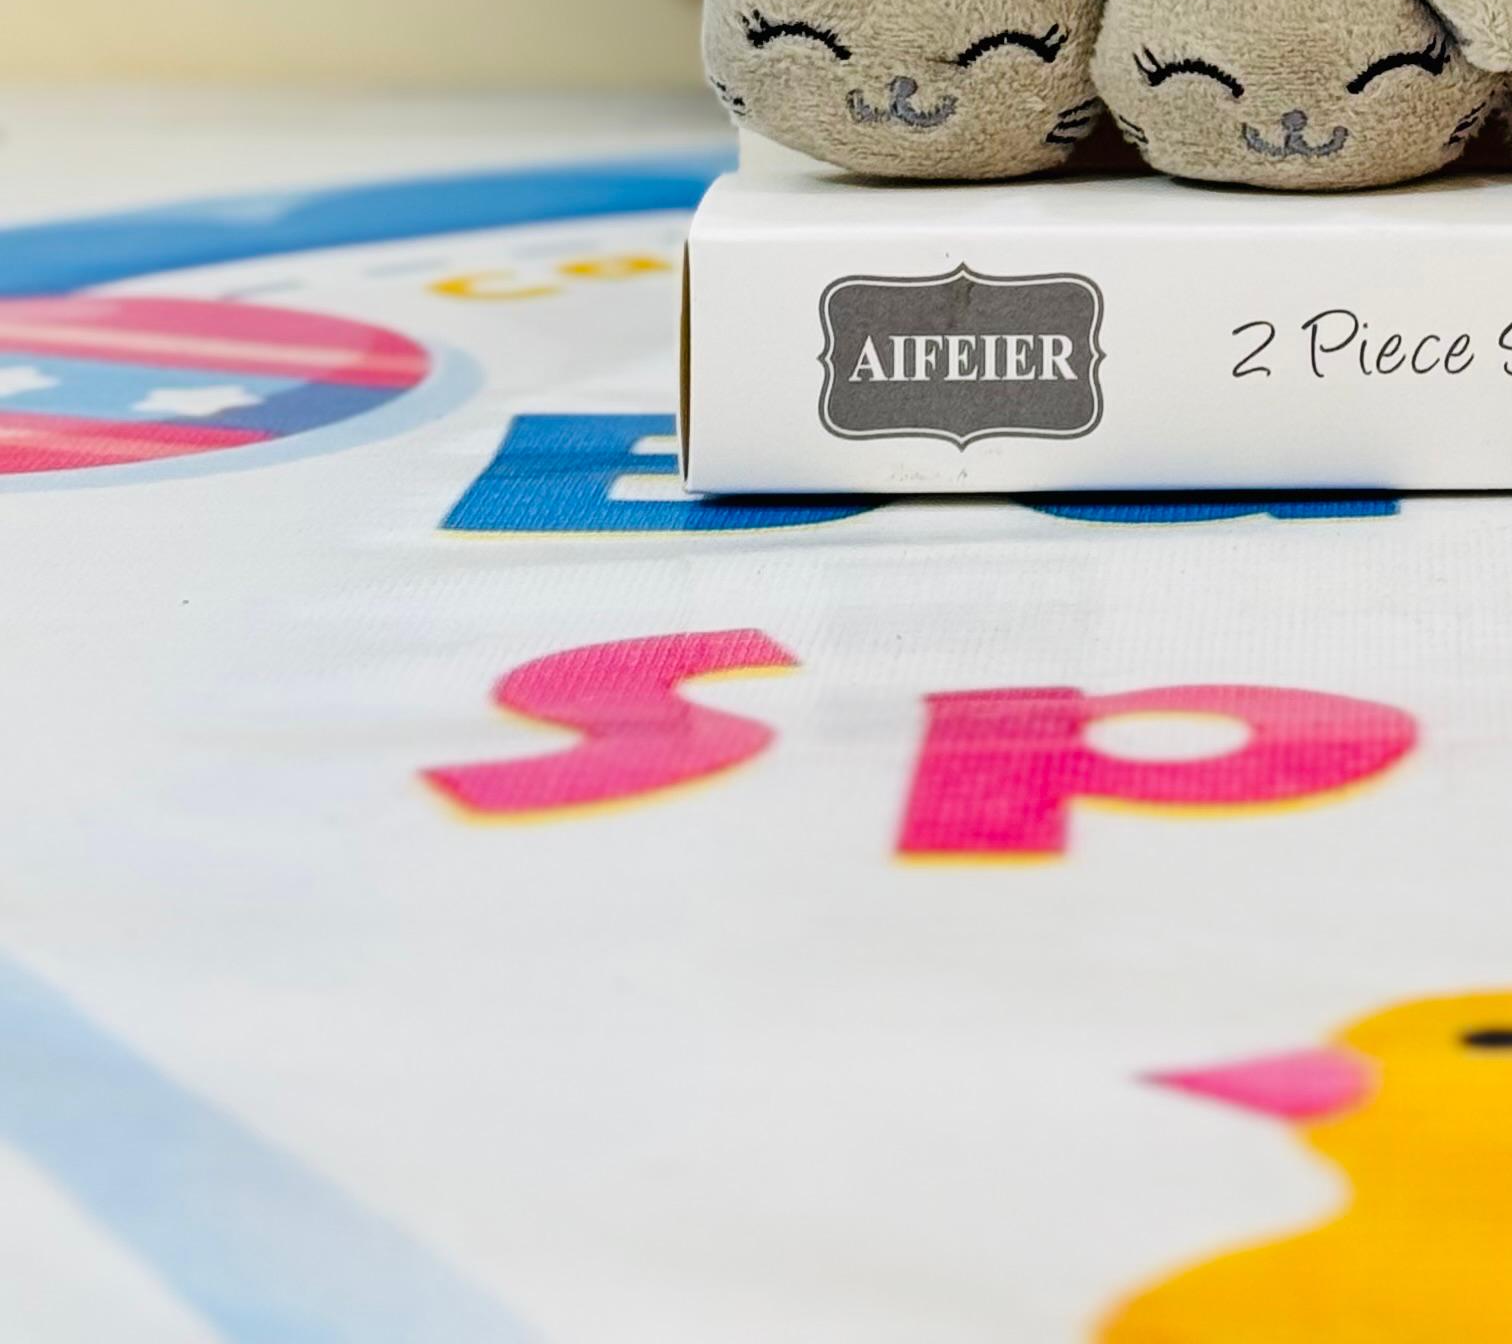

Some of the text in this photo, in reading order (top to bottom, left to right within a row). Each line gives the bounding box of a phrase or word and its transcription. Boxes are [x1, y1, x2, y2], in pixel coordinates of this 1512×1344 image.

[848, 333, 1079, 383] AIFEIER
[1231, 320, 1276, 378] 2
[1300, 308, 1475, 379] Piece
